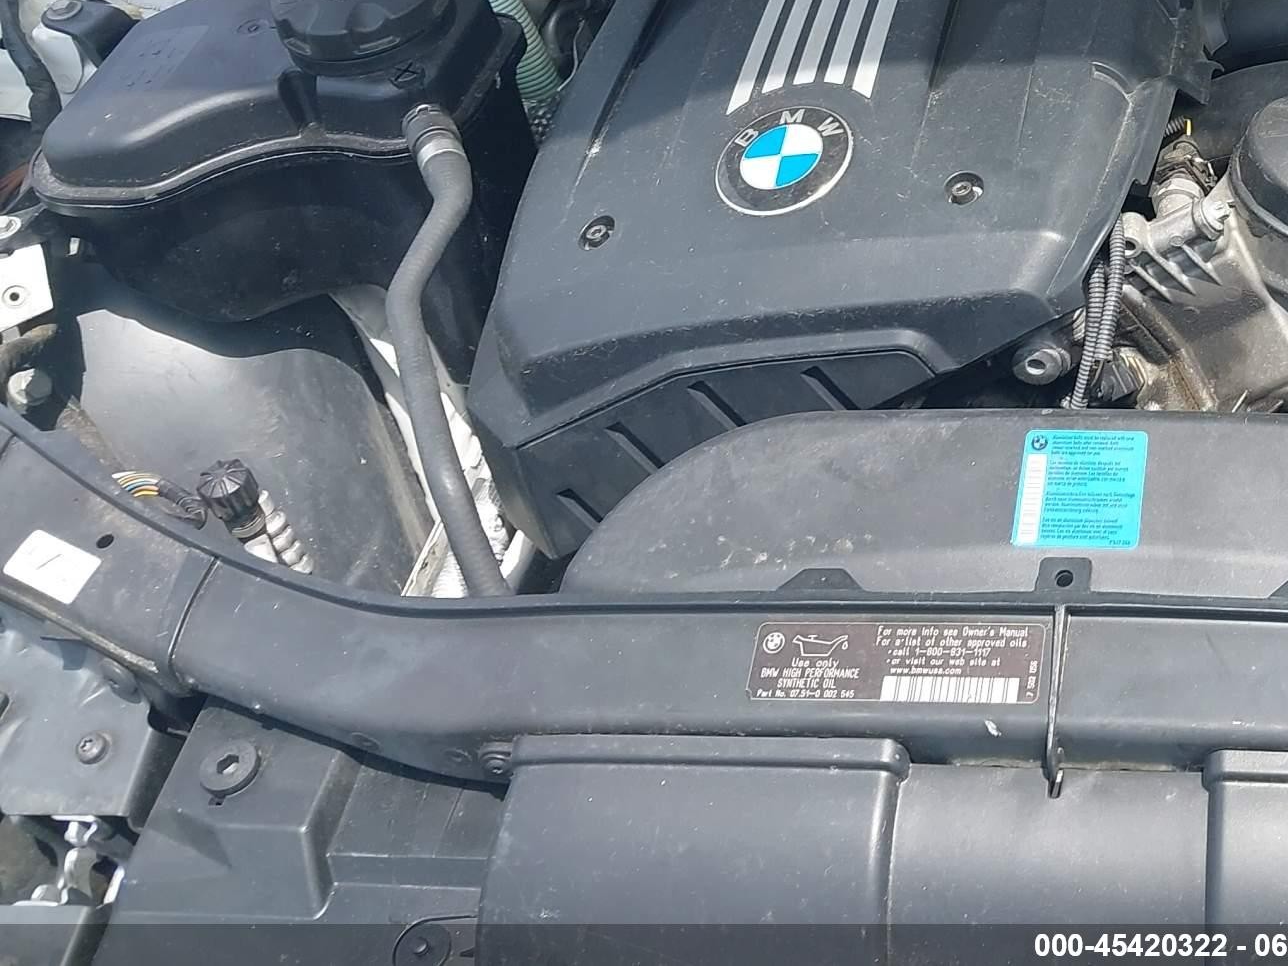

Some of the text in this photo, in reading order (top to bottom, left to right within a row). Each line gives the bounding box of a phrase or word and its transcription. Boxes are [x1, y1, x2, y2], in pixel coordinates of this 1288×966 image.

[734, 108, 845, 148] BMW
[877, 625, 892, 636] For
[896, 628, 917, 636] more
[943, 629, 959, 637] see
[963, 626, 995, 637] Owner's
[999, 626, 1028, 638] Manual
[875, 636, 891, 646] For
[925, 636, 935, 647] of
[939, 636, 962, 647] other
[967, 637, 1007, 649] approved
[1009, 637, 1028, 648] oils
[791, 657, 839, 670] Use only
[905, 656, 926, 666] visit
[930, 658, 945, 666] our
[949, 656, 966, 667] web
[969, 657, 987, 667] site
[991, 657, 1001, 667] at
[760, 667, 860, 679] BMW HIGH PERFORMANCE
[889, 666, 962, 675] www.bmwusa.com
[776, 677, 837, 689] SYNTHETIC OIL
[756, 688, 772, 698] Part
